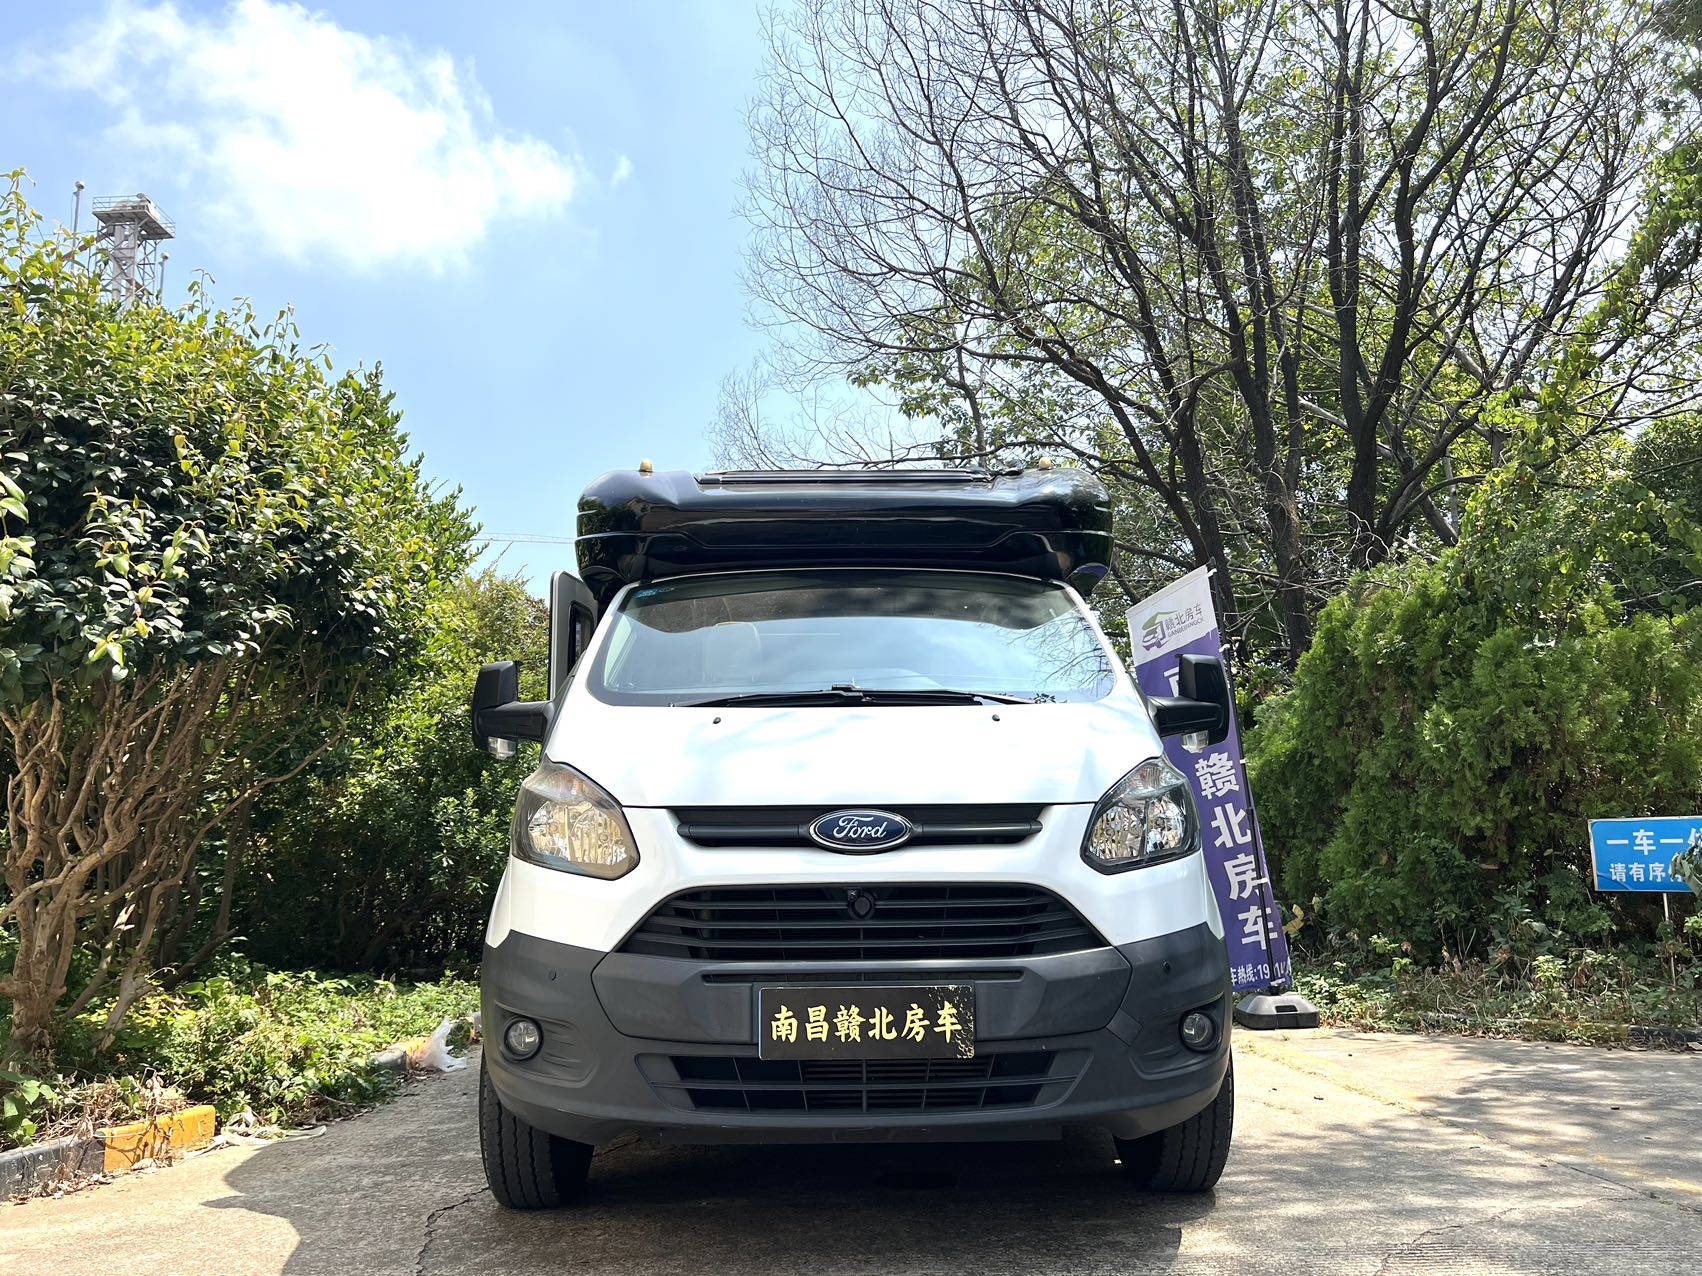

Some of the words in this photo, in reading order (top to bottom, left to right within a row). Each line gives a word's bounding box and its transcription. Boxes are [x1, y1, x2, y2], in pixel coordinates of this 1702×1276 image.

[833, 815, 888, 838] Ford
[1194, 751, 1278, 951] 赣北房车
[770, 1000, 963, 1044] 南昌赣北房车
